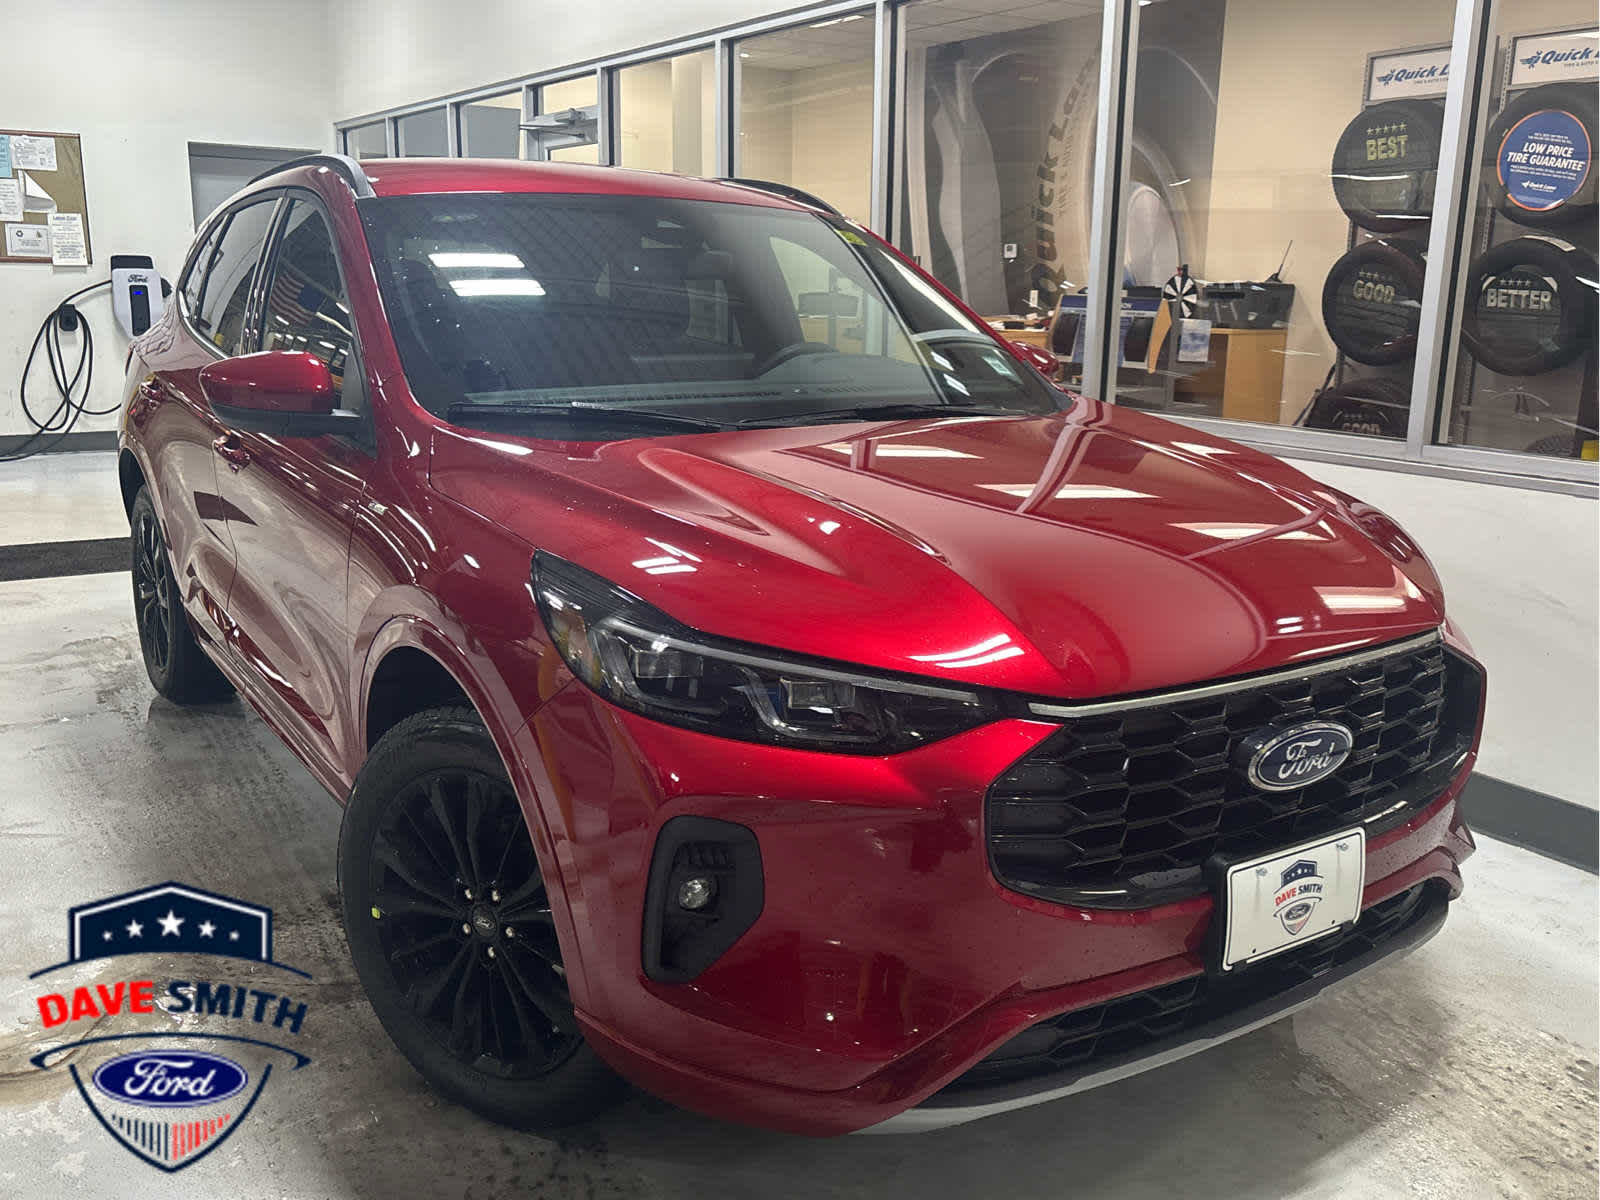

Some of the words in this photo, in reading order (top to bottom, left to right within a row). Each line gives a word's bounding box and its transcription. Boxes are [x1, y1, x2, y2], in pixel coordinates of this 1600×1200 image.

[1541, 47, 1594, 65] Quick
[1394, 65, 1440, 82] Quick
[1365, 135, 1408, 161] BEST
[1522, 142, 1547, 155] LOW
[1546, 144, 1575, 158] PRICE
[1507, 151, 1530, 164] TIRE
[1529, 154, 1586, 171] GUARANTEE
[128, 273, 149, 283] Ford
[1353, 280, 1396, 304] GOOD
[1486, 288, 1552, 311] BETTER
[1277, 738, 1335, 779] Ford
[1275, 887, 1297, 907] DAVE
[1297, 883, 1323, 895] SMITH
